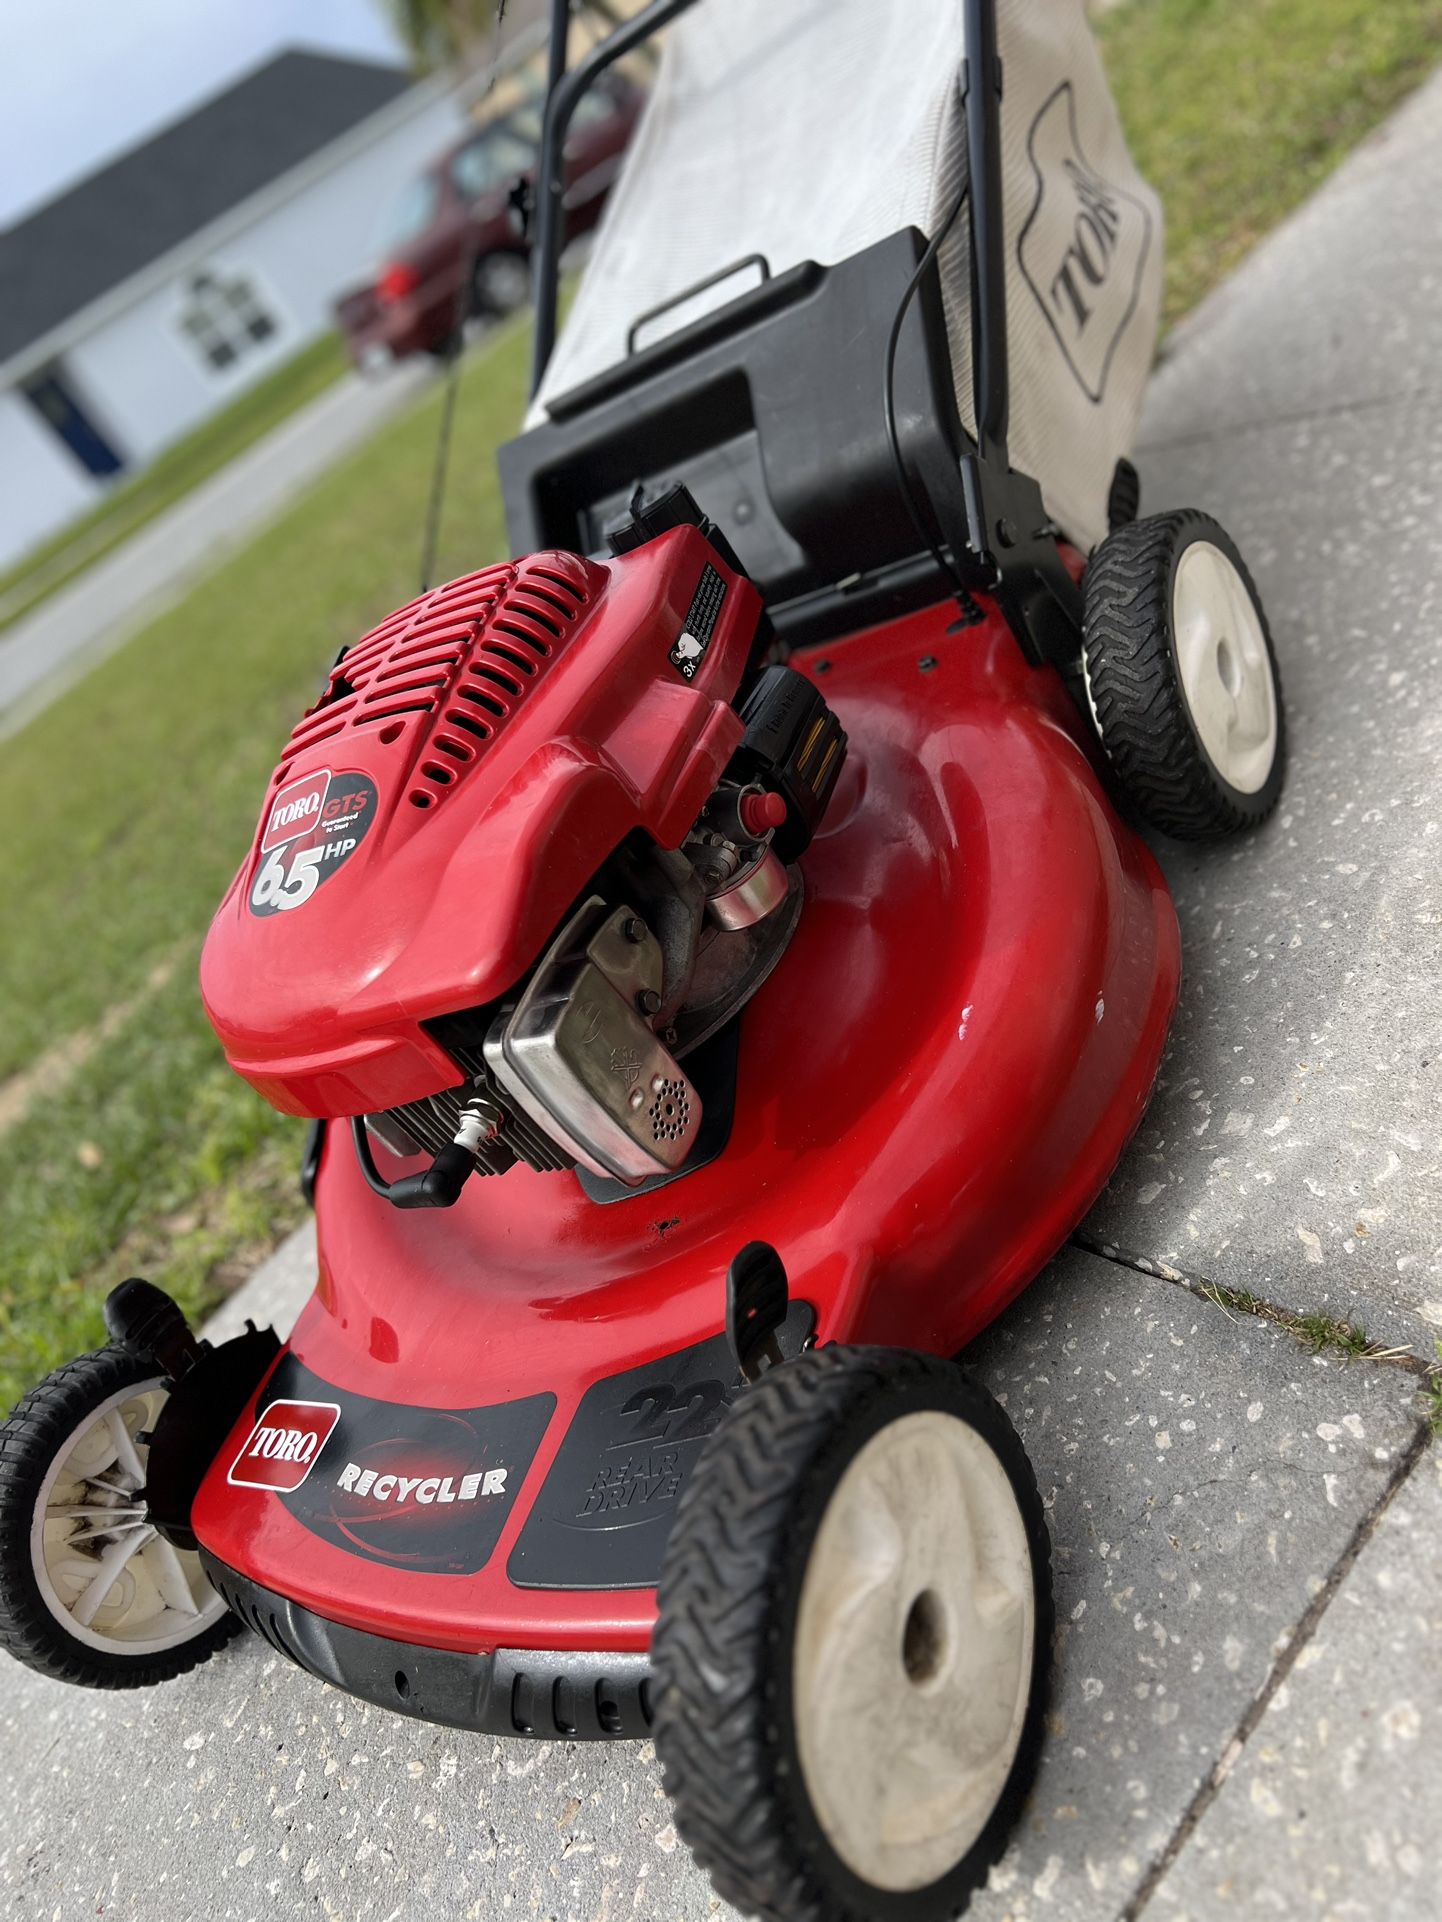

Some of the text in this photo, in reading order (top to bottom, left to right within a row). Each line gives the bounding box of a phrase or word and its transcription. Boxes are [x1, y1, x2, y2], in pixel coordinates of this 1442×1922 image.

[683, 661, 696, 678] 3x
[322, 790, 369, 819] GTS
[324, 838, 357, 861] HP
[336, 1462, 508, 1505] RECYCLER
[586, 1451, 679, 1493] REAR
[575, 1472, 683, 1518] DRIVE
